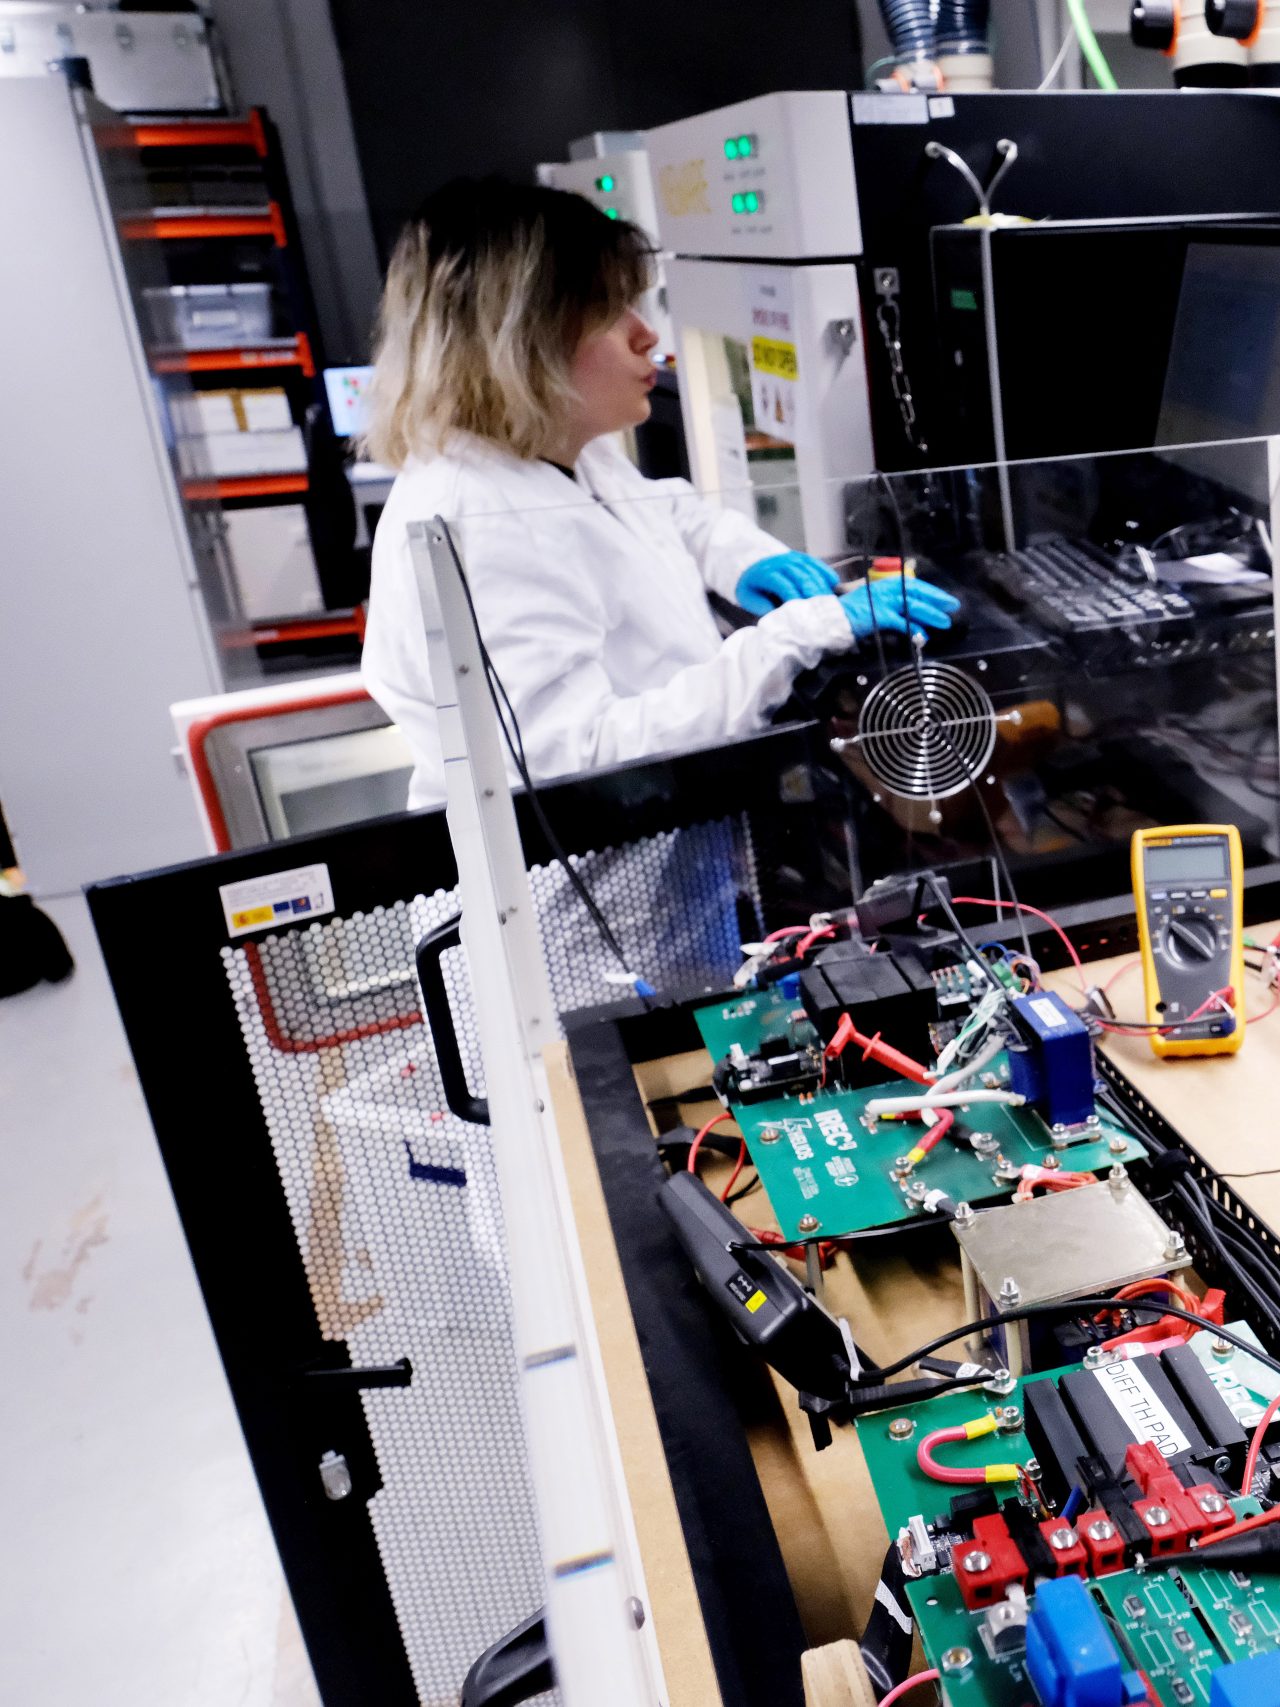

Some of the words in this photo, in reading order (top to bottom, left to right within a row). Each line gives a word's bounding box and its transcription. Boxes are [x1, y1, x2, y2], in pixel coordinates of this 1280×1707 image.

[1105, 1362, 1141, 1395] DIFF
[1130, 1398, 1156, 1421] TH
[1144, 1422, 1179, 1457] PAD
